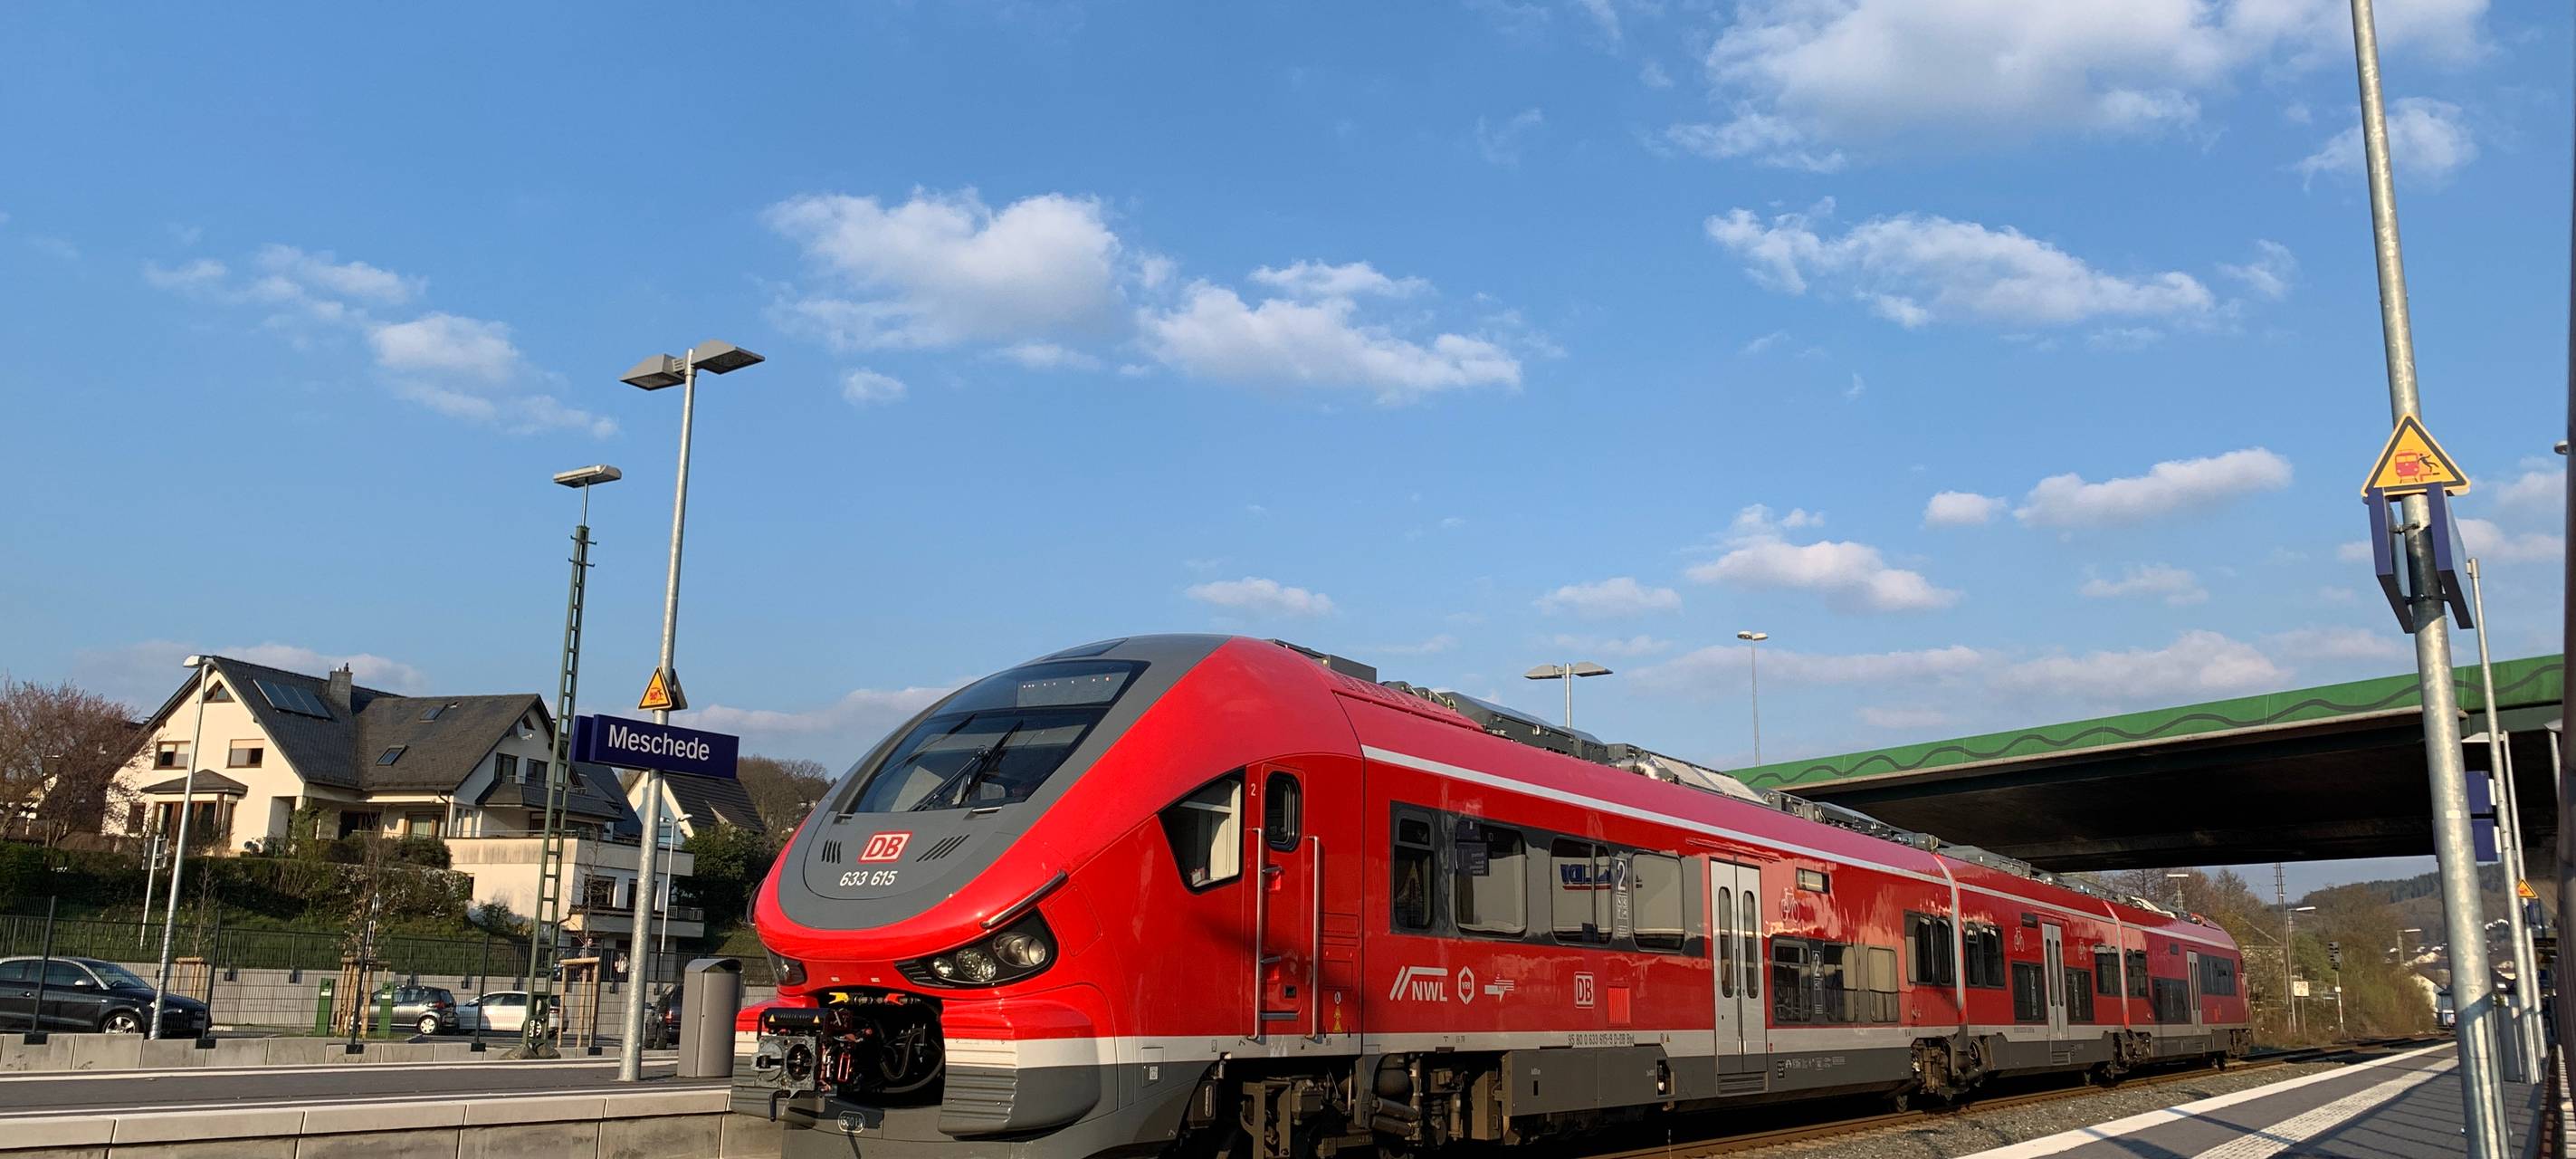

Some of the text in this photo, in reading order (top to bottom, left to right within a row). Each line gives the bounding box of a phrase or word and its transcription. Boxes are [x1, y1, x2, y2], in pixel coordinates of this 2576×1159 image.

[608, 724, 710, 761] Meschede
[1250, 782, 1256, 797] 2
[863, 835, 902, 859] DB
[840, 870, 898, 886] 633 615
[1617, 860, 1627, 891] 2
[1814, 953, 1821, 977] 2
[1412, 981, 1448, 1002] NWL
[1576, 976, 1593, 1004] DB
